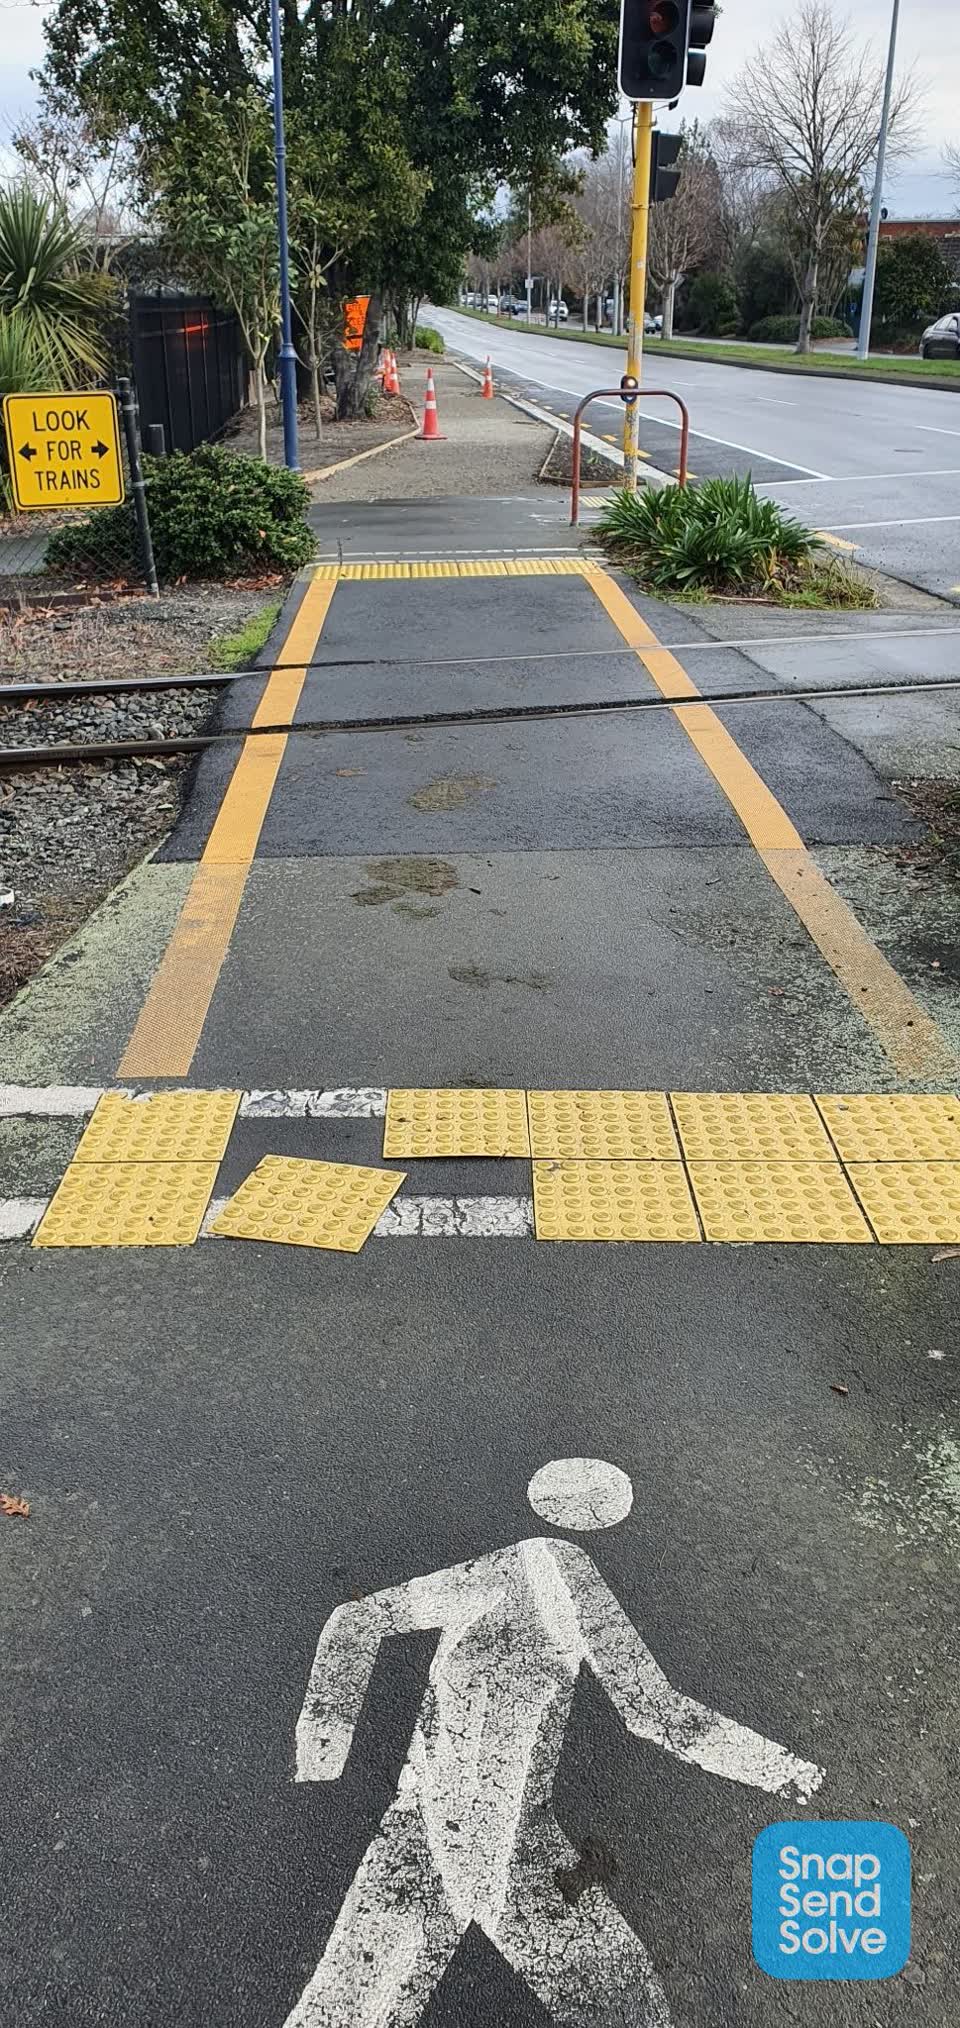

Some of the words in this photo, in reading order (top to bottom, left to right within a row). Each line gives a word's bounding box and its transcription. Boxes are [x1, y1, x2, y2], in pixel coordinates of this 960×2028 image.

[33, 410, 90, 431] LOOK
[46, 440, 82, 461] FOR
[34, 468, 101, 491] TRAINS
